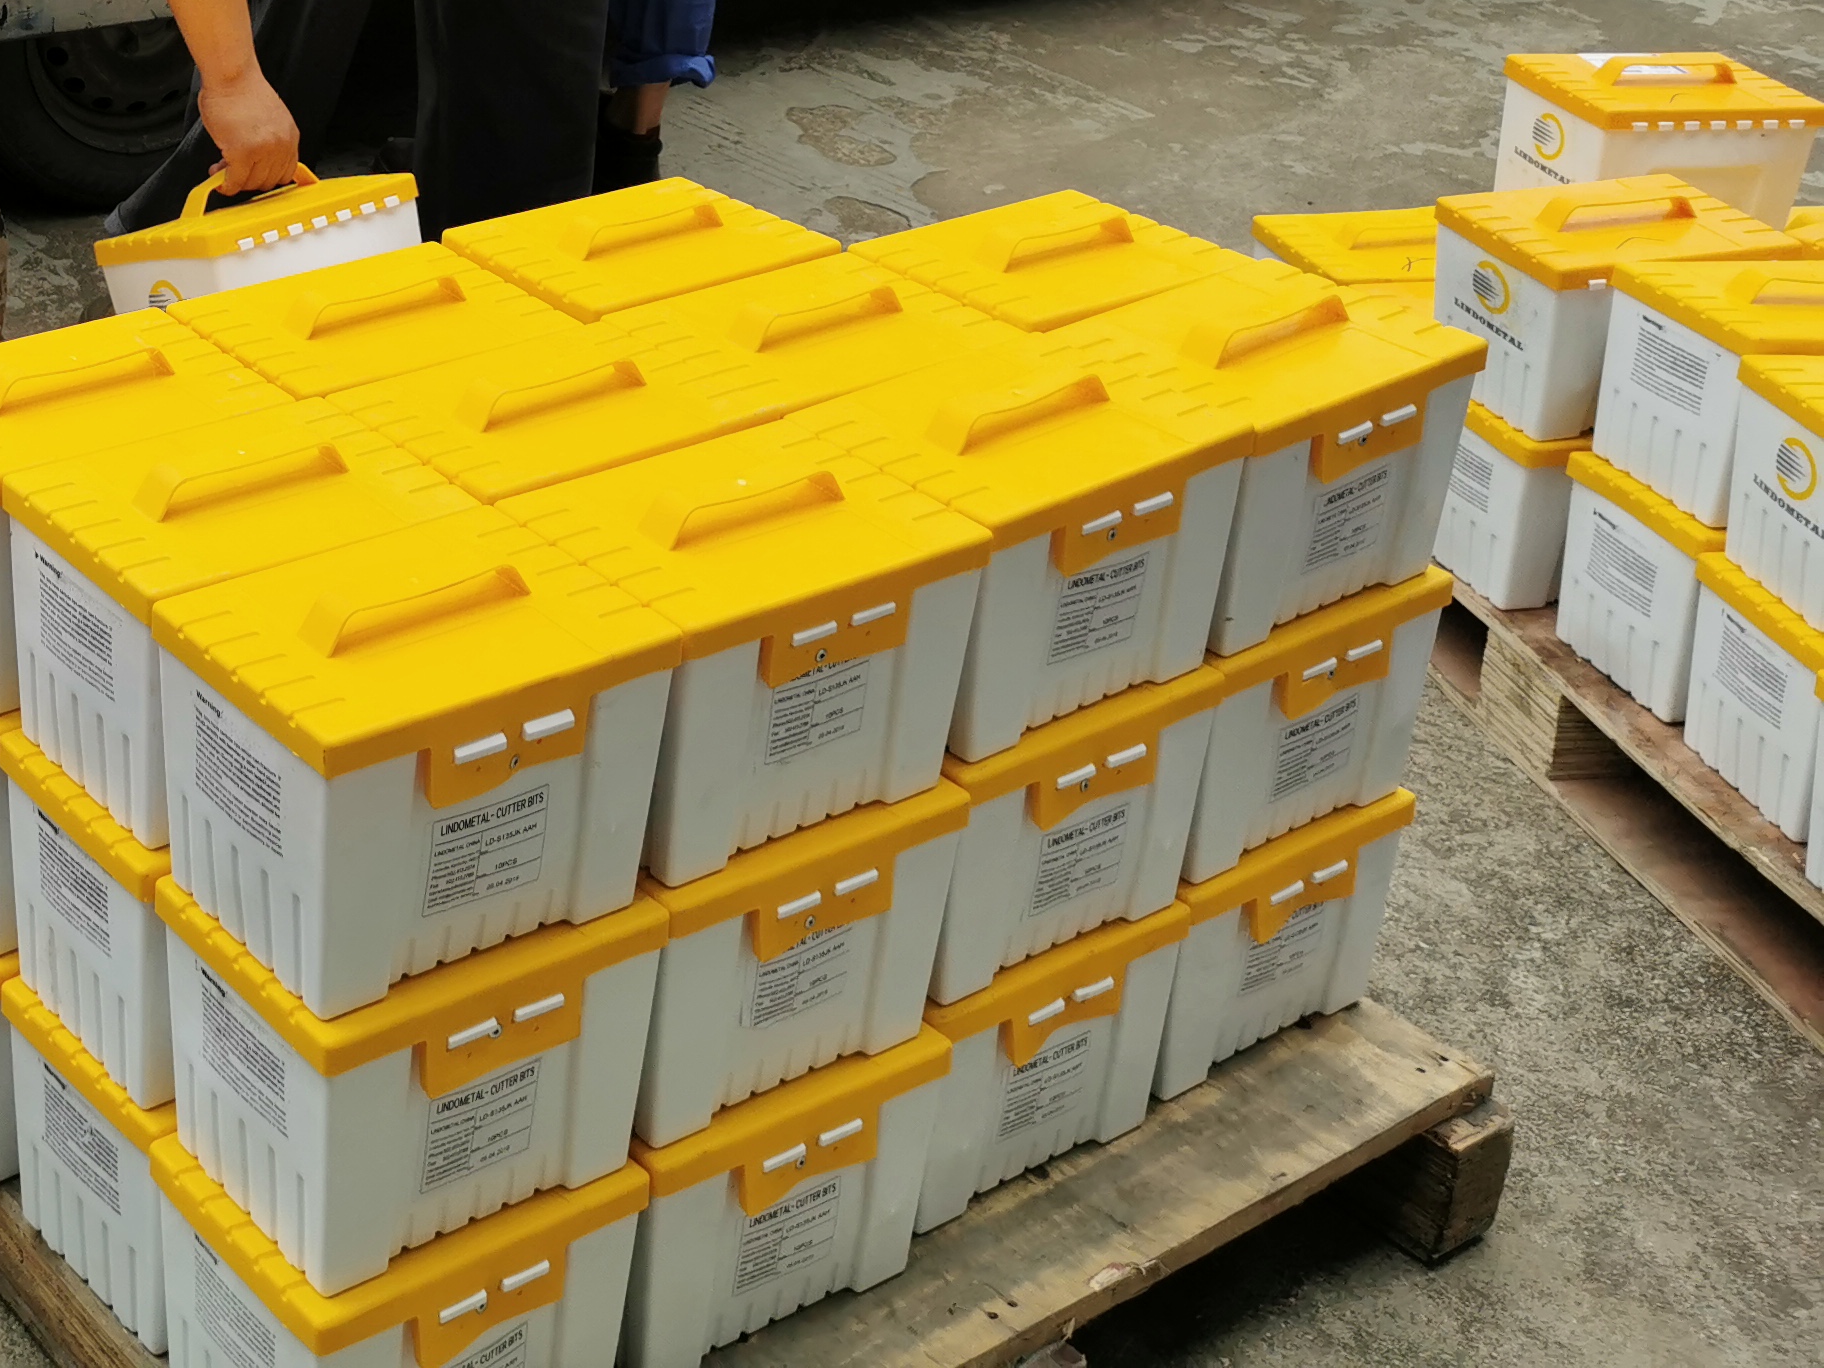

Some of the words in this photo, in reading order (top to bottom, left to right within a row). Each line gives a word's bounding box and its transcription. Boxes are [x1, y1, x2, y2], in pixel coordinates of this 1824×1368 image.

[1454, 297, 1523, 351] LINDOMETAL
[496, 798, 526, 819] CUTTER
[528, 792, 544, 807] BITS
[491, 1074, 518, 1096] CUTTER
[519, 1066, 535, 1082] BITS
[480, 1341, 507, 1364] CUTTER
